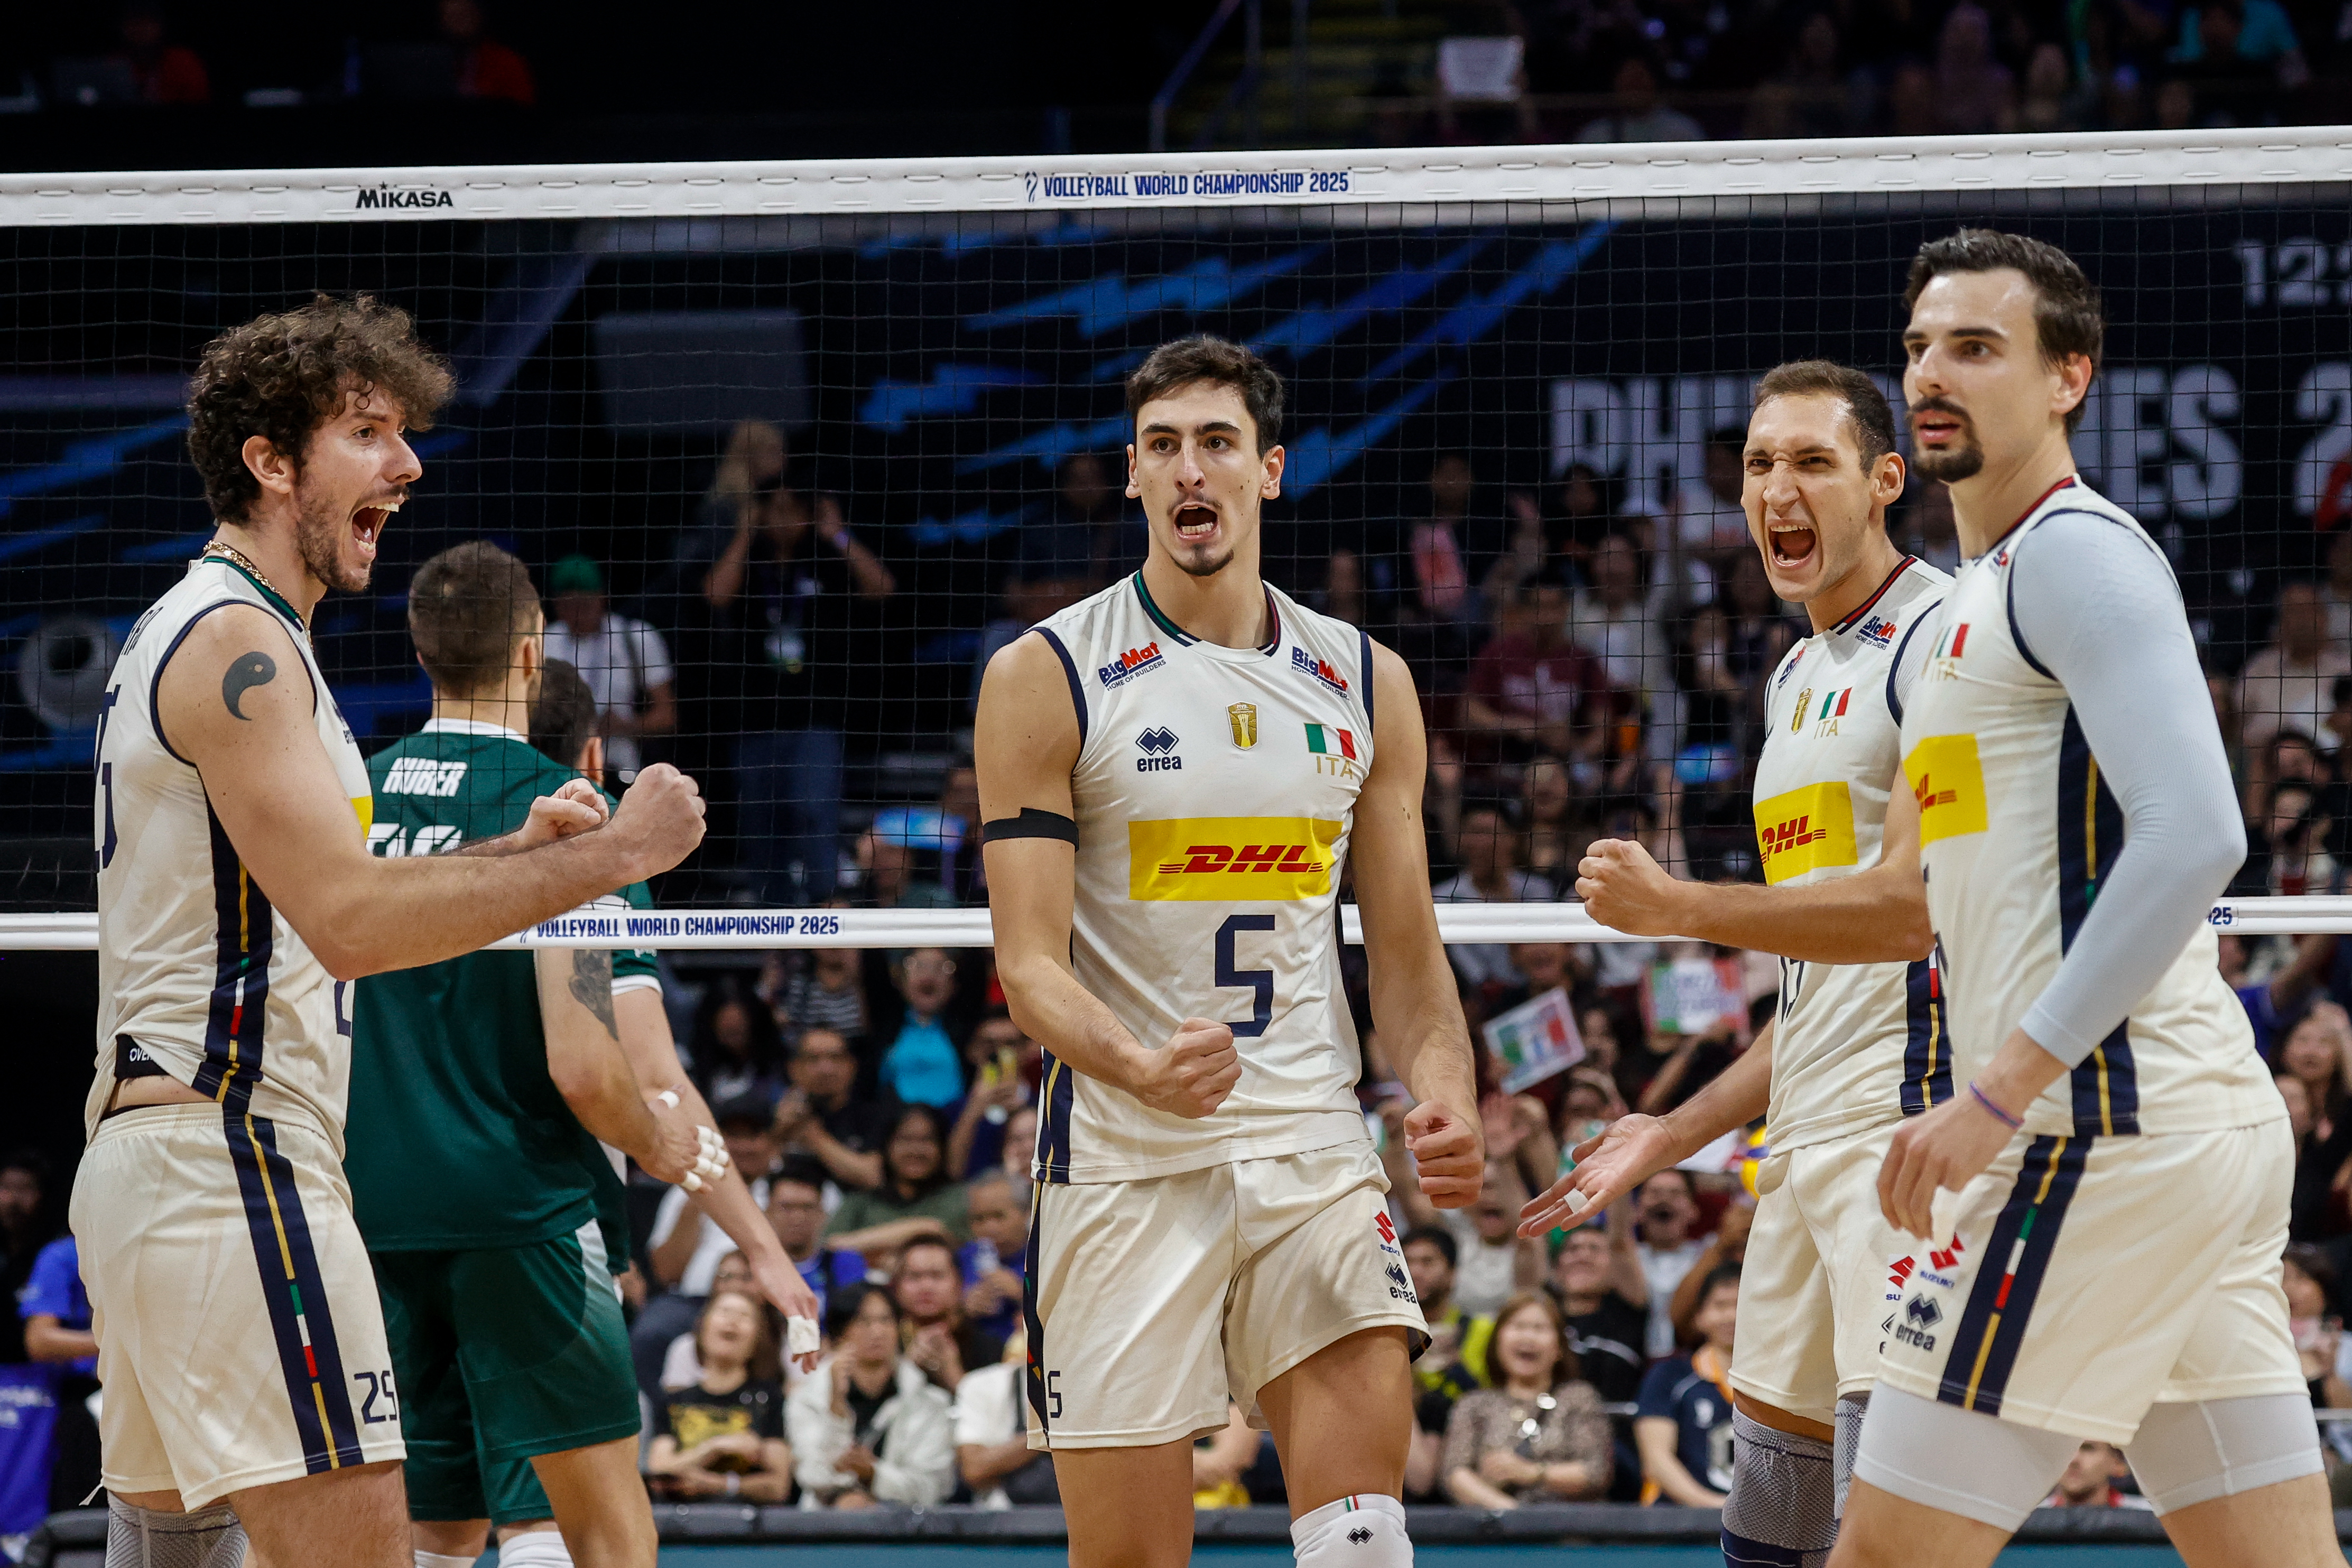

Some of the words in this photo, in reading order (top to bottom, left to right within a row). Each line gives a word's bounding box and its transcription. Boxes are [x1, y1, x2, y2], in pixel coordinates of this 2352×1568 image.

[356, 188, 453, 208] MIKASA
[1043, 176, 1128, 197] VOLLEYBALL
[1134, 175, 1188, 196] WORLD
[1193, 172, 1304, 194] CHAMPIONSHIP
[1310, 172, 1349, 192] 2025
[1098, 641, 1161, 685] BigMat
[1107, 679, 1125, 691] HOME
[1125, 674, 1135, 683] OF
[1136, 659, 1166, 678] BUILDERS
[1321, 681, 1350, 701] BUILDER
[1813, 719, 1838, 740] ITA
[1136, 756, 1182, 772] errea
[1317, 755, 1354, 780] ITA
[1762, 814, 1813, 862] DHL
[1182, 845, 1309, 874] DHL
[536, 919, 620, 938] VOLLEYBALL
[626, 917, 680, 937] WORLD
[685, 916, 794, 935] CHAMPIONSHIP
[800, 916, 839, 935] 2025
[1215, 914, 1275, 1037] 5
[354, 1370, 397, 1424] 25
[1047, 1370, 1062, 1419] 5
